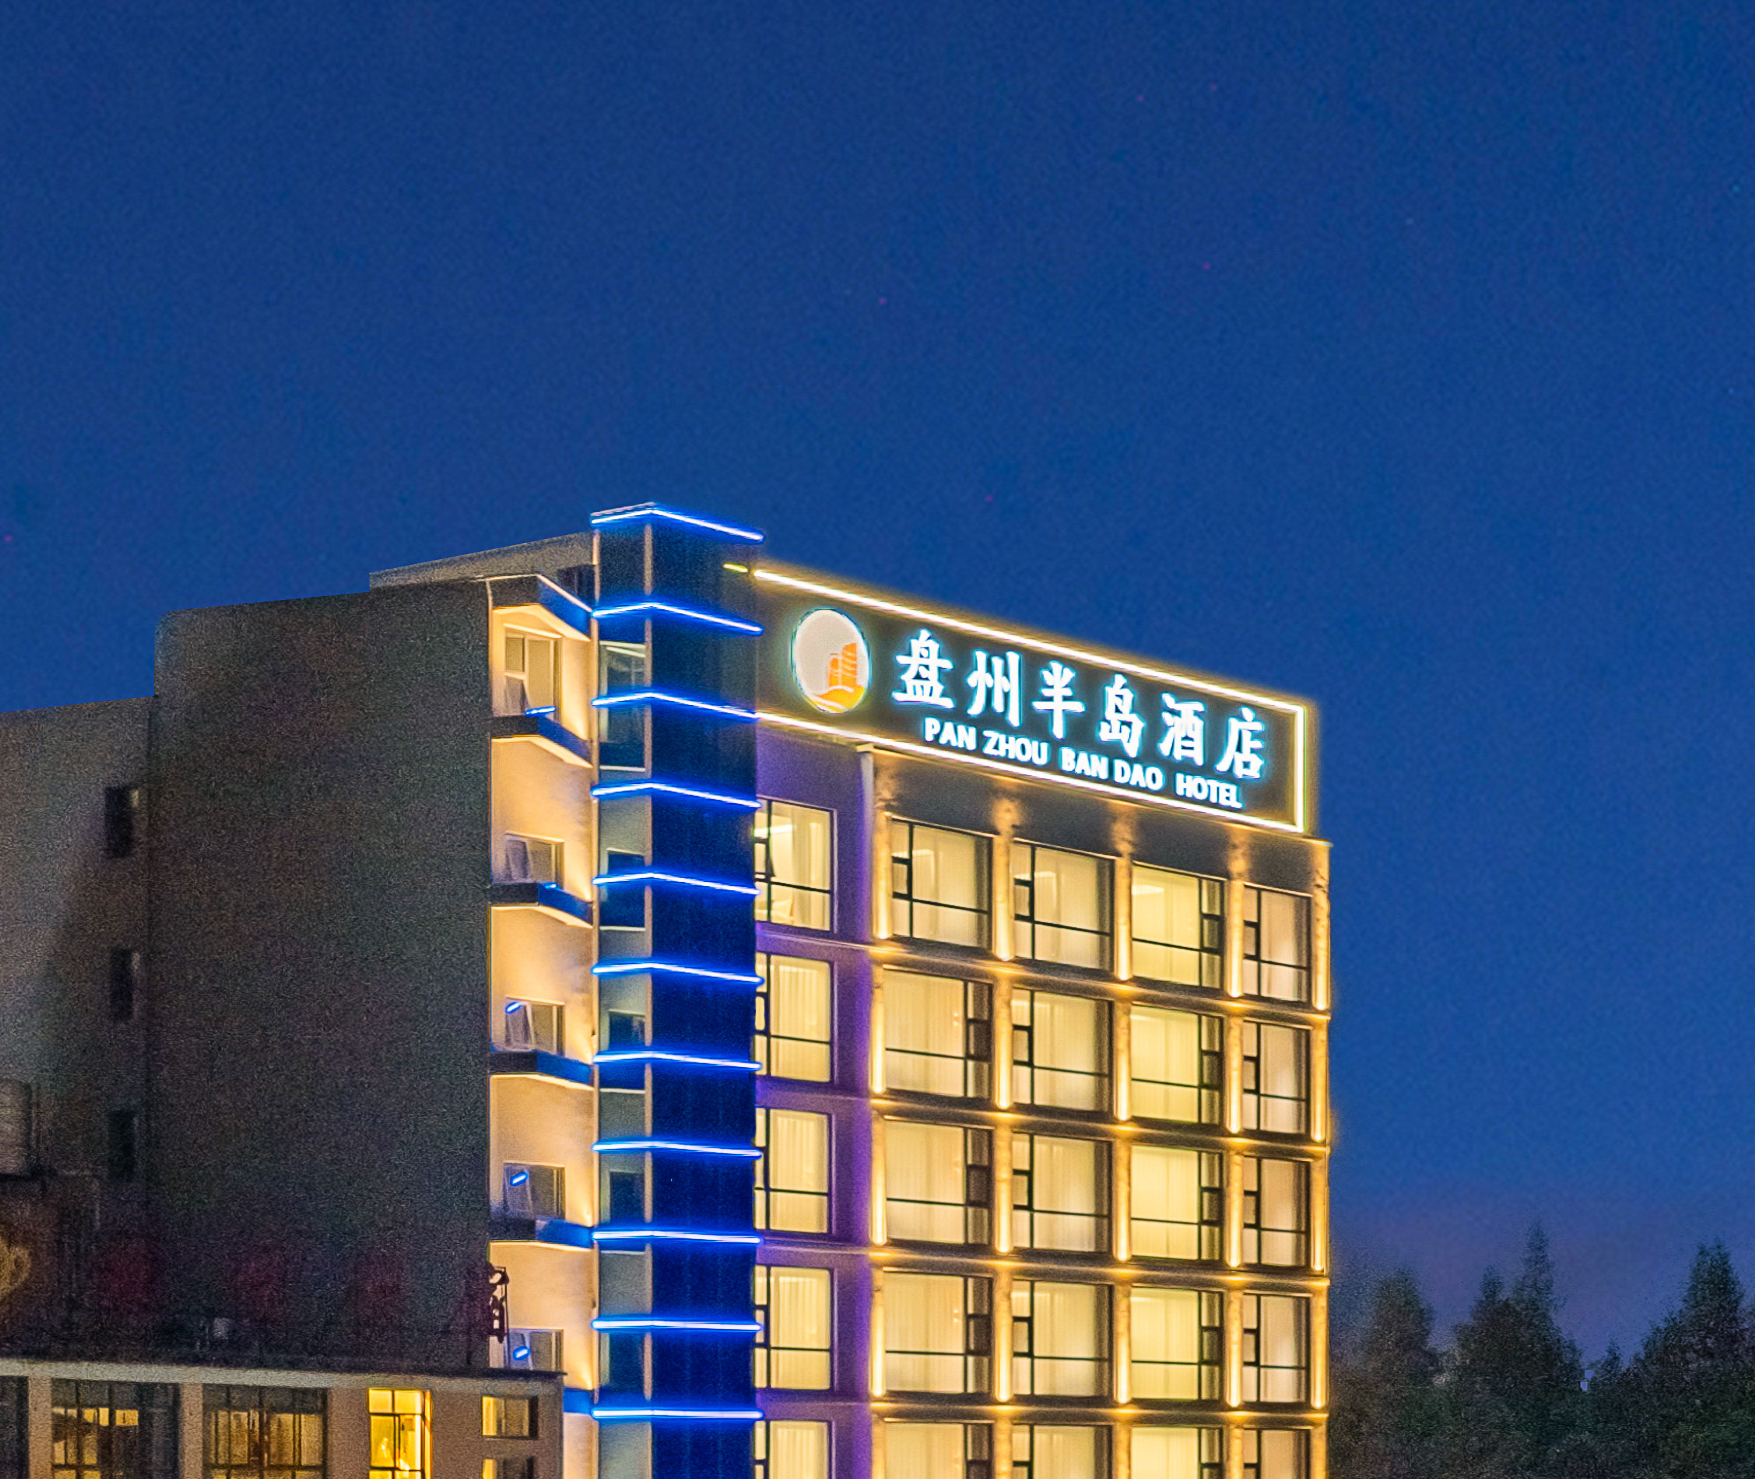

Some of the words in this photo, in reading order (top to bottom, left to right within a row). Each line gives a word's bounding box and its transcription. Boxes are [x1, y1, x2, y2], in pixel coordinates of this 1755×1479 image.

[891, 628, 1265, 781] 盘州半岛酒店
[924, 717, 977, 751] PAN
[982, 730, 1049, 766] ZHOU
[1060, 747, 1109, 780] BAN
[1113, 760, 1164, 791] DAO
[1175, 772, 1243, 809] HOTEL
